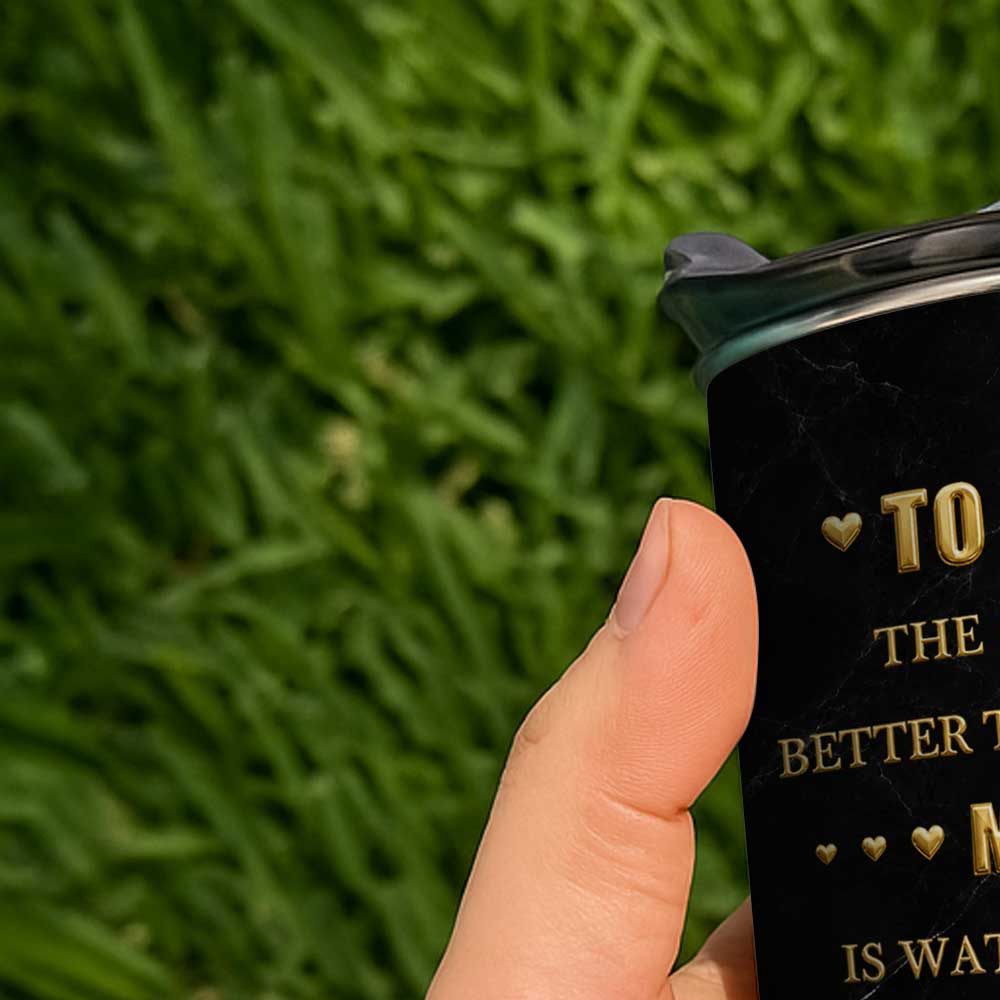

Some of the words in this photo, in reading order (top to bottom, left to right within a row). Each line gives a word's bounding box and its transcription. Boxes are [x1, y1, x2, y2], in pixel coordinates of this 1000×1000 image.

[881, 482, 985, 573] TO
[872, 614, 985, 667] THE
[778, 713, 974, 777] BETTER
[842, 942, 886, 982] IS
